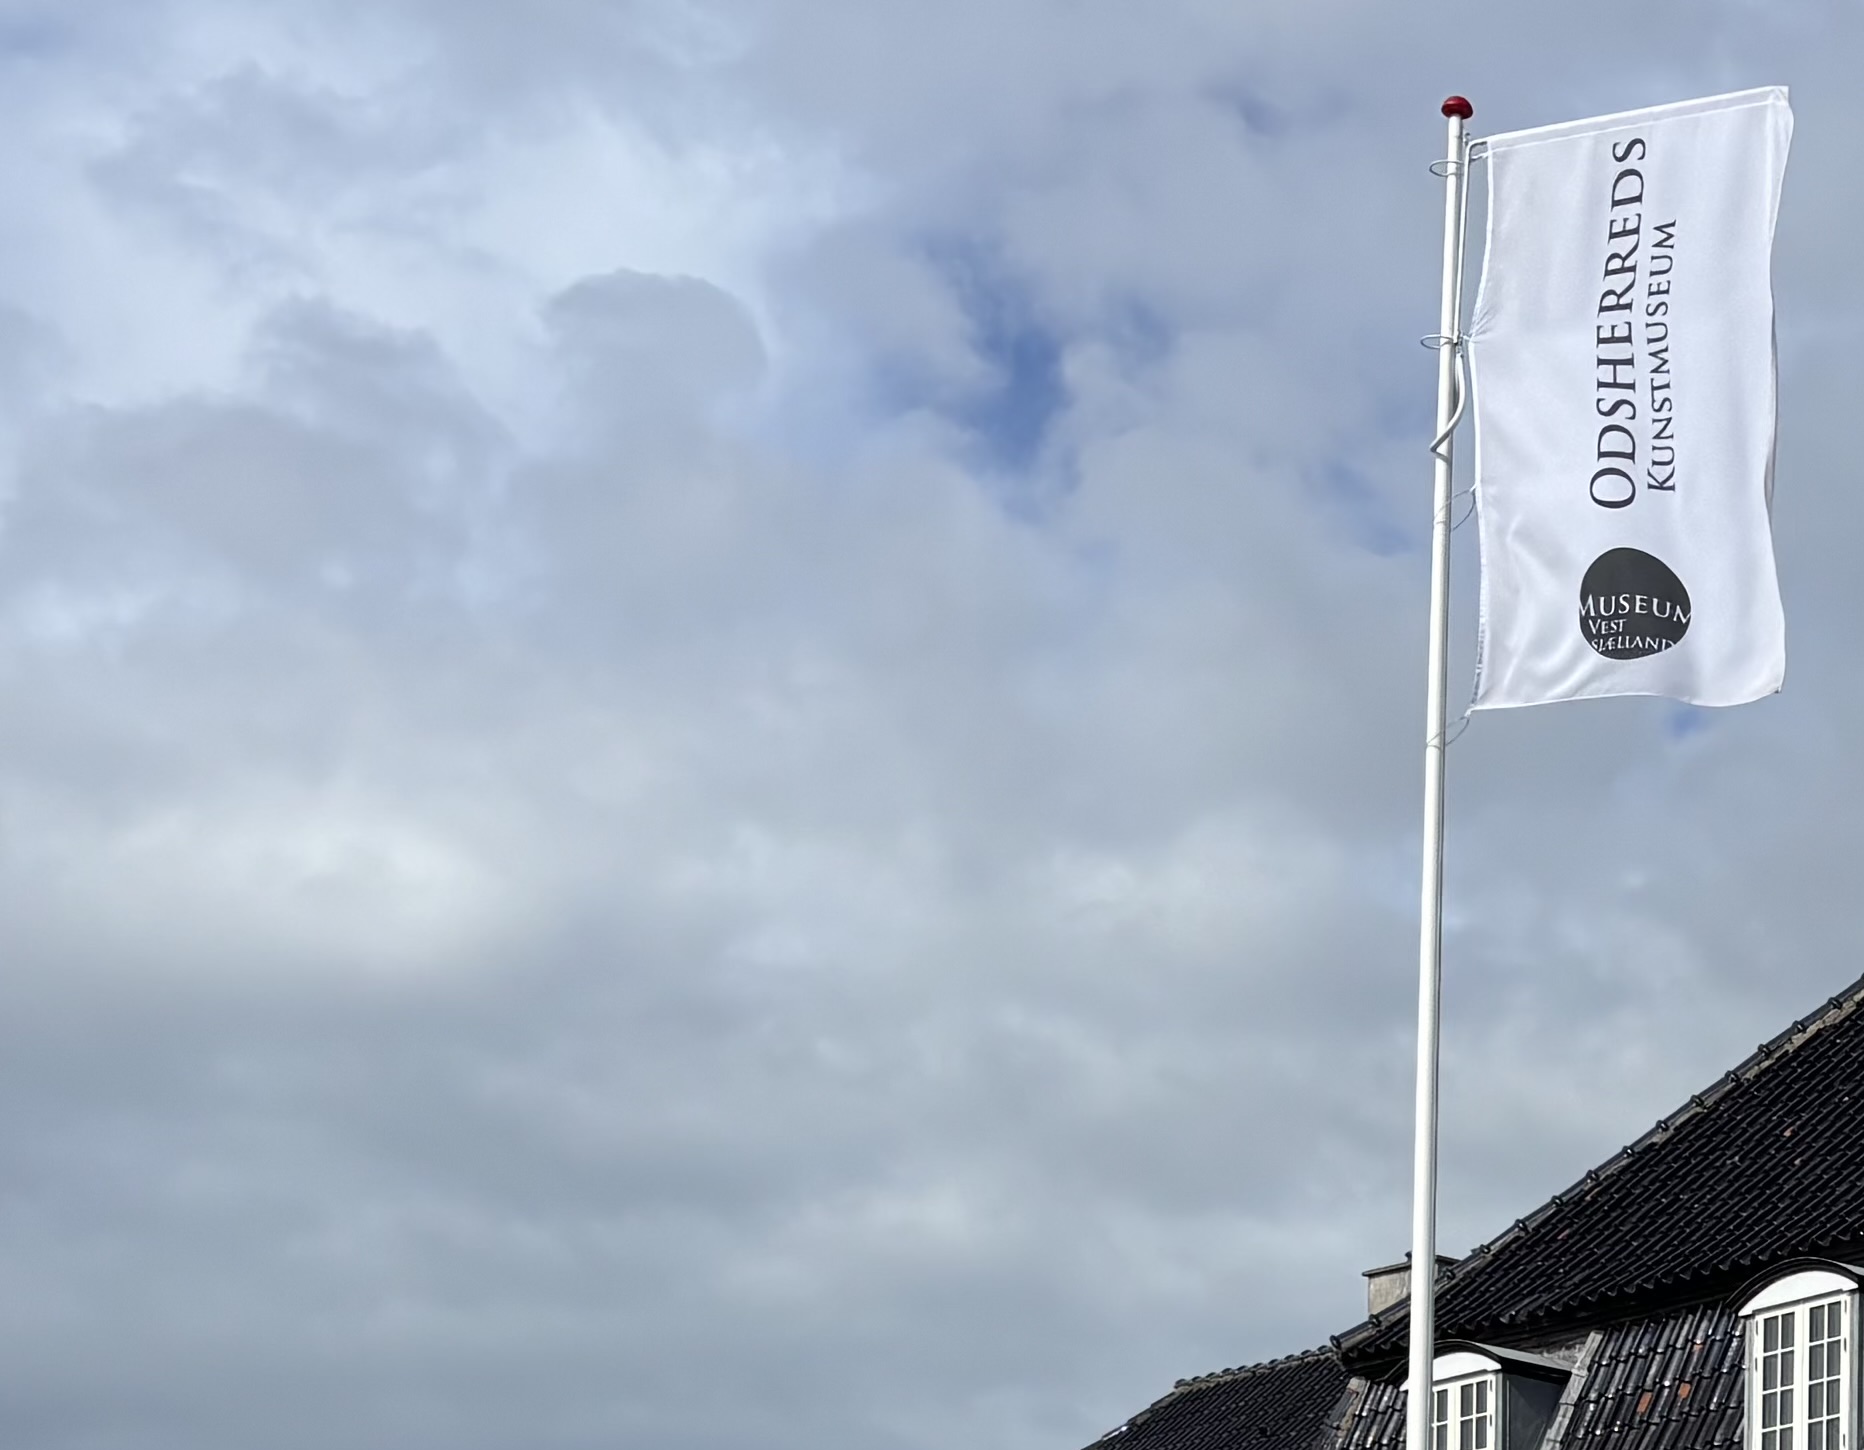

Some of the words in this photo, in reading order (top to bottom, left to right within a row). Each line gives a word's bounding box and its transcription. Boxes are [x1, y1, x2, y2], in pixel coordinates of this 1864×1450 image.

[1589, 137, 1647, 509] ODSHERREDS
[1645, 219, 1678, 493] KUNSTMUSEUM
[1579, 593, 1691, 624] MUSEUM
[1588, 618, 1627, 635] VEST
